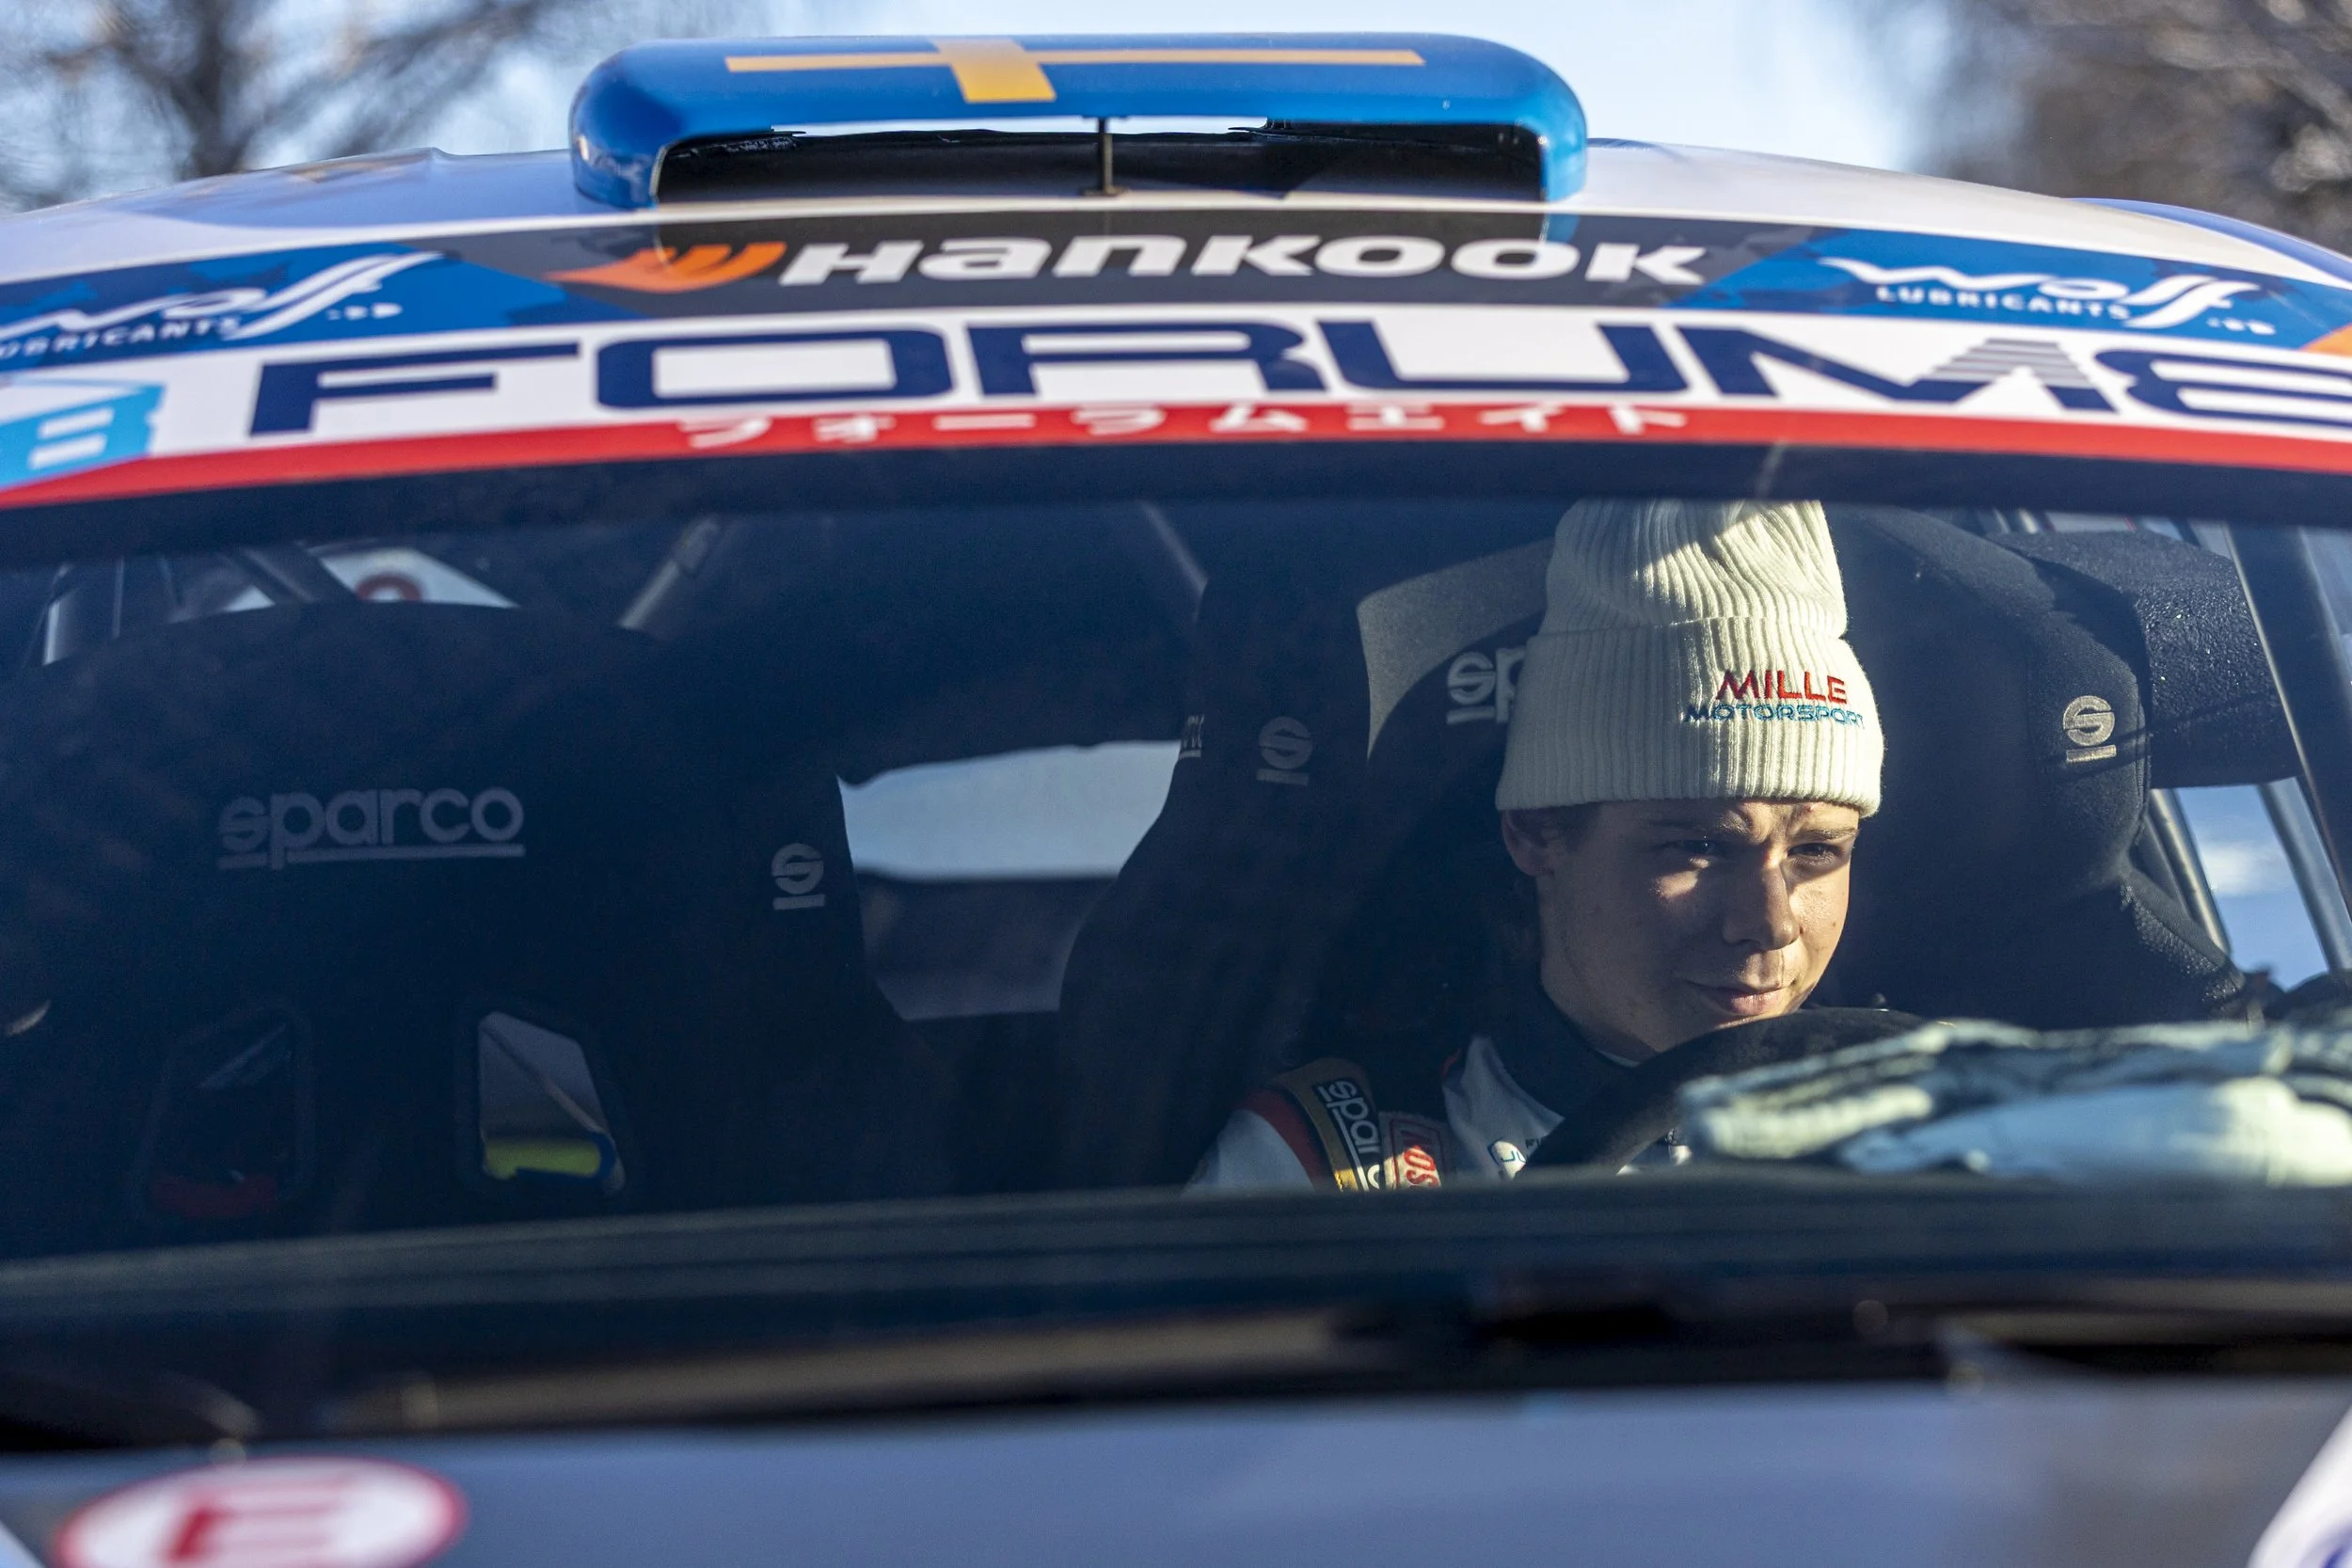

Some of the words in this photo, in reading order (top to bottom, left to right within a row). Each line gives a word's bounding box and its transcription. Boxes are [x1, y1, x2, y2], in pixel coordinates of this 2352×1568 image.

[1876, 285, 2130, 321] LUBRICANTS
[1714, 670, 1848, 705] MILLE
[1684, 704, 1866, 730] MOTORSPORT
[217, 786, 526, 870] sparco
